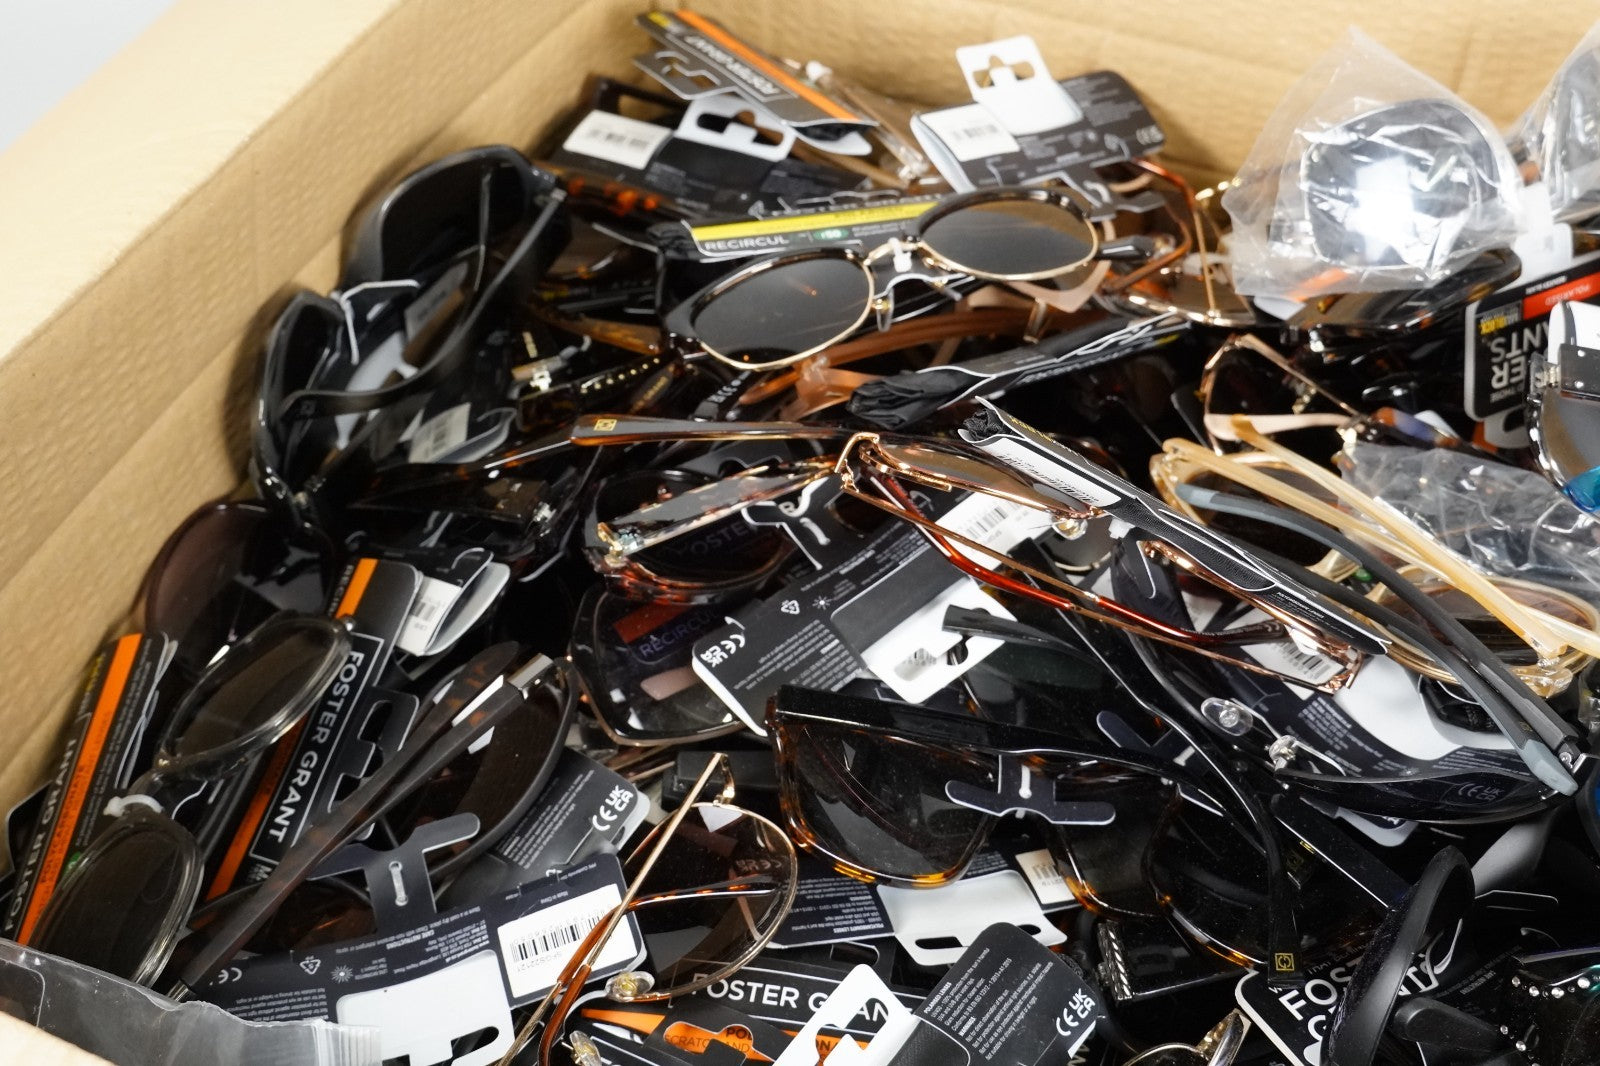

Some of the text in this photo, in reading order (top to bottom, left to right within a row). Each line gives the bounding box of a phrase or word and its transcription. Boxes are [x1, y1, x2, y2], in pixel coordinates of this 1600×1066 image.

[309, 647, 365, 747] FOSTER
[40, 735, 78, 826] GRANT
[265, 747, 320, 843] GRANT
[592, 805, 618, 831] CE
[808, 991, 913, 1022] GAN
[1056, 1008, 1079, 1036] CE
[666, 1034, 709, 1052] SCRATC
